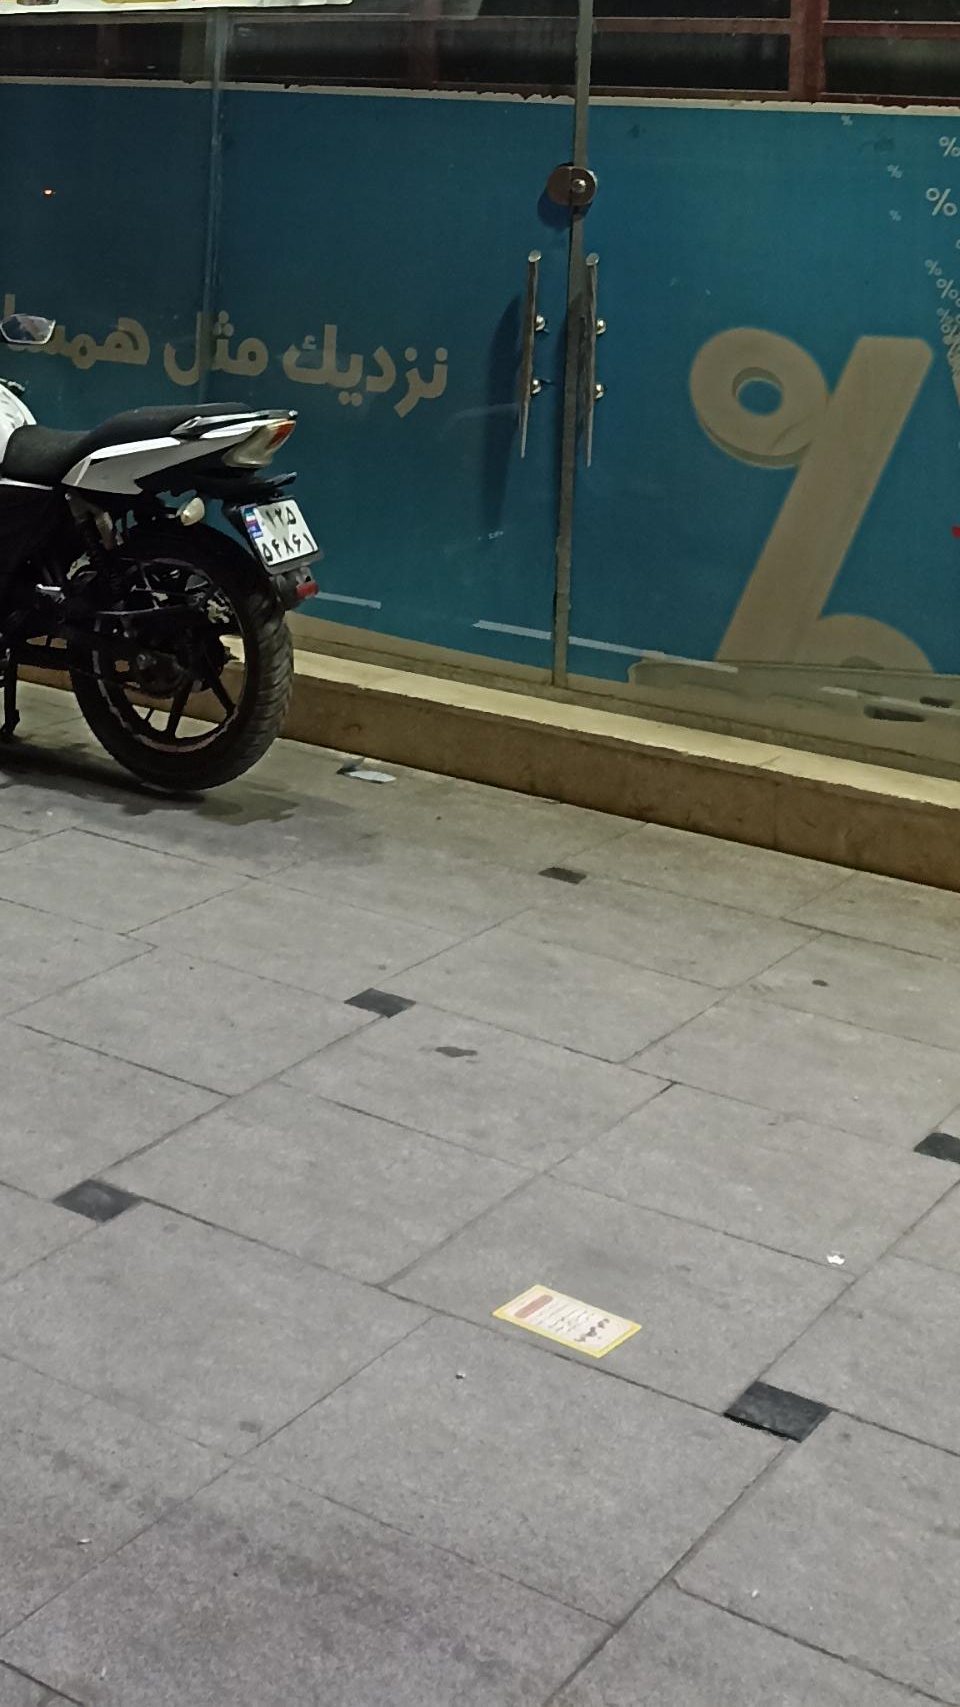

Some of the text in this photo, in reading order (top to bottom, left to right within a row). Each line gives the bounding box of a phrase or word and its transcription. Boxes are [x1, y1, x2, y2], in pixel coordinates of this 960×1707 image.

[163, 310, 269, 388] مثل
[265, 506, 297, 528] ۱۲۵
[262, 533, 316, 563] ۵۴۸۶۱
